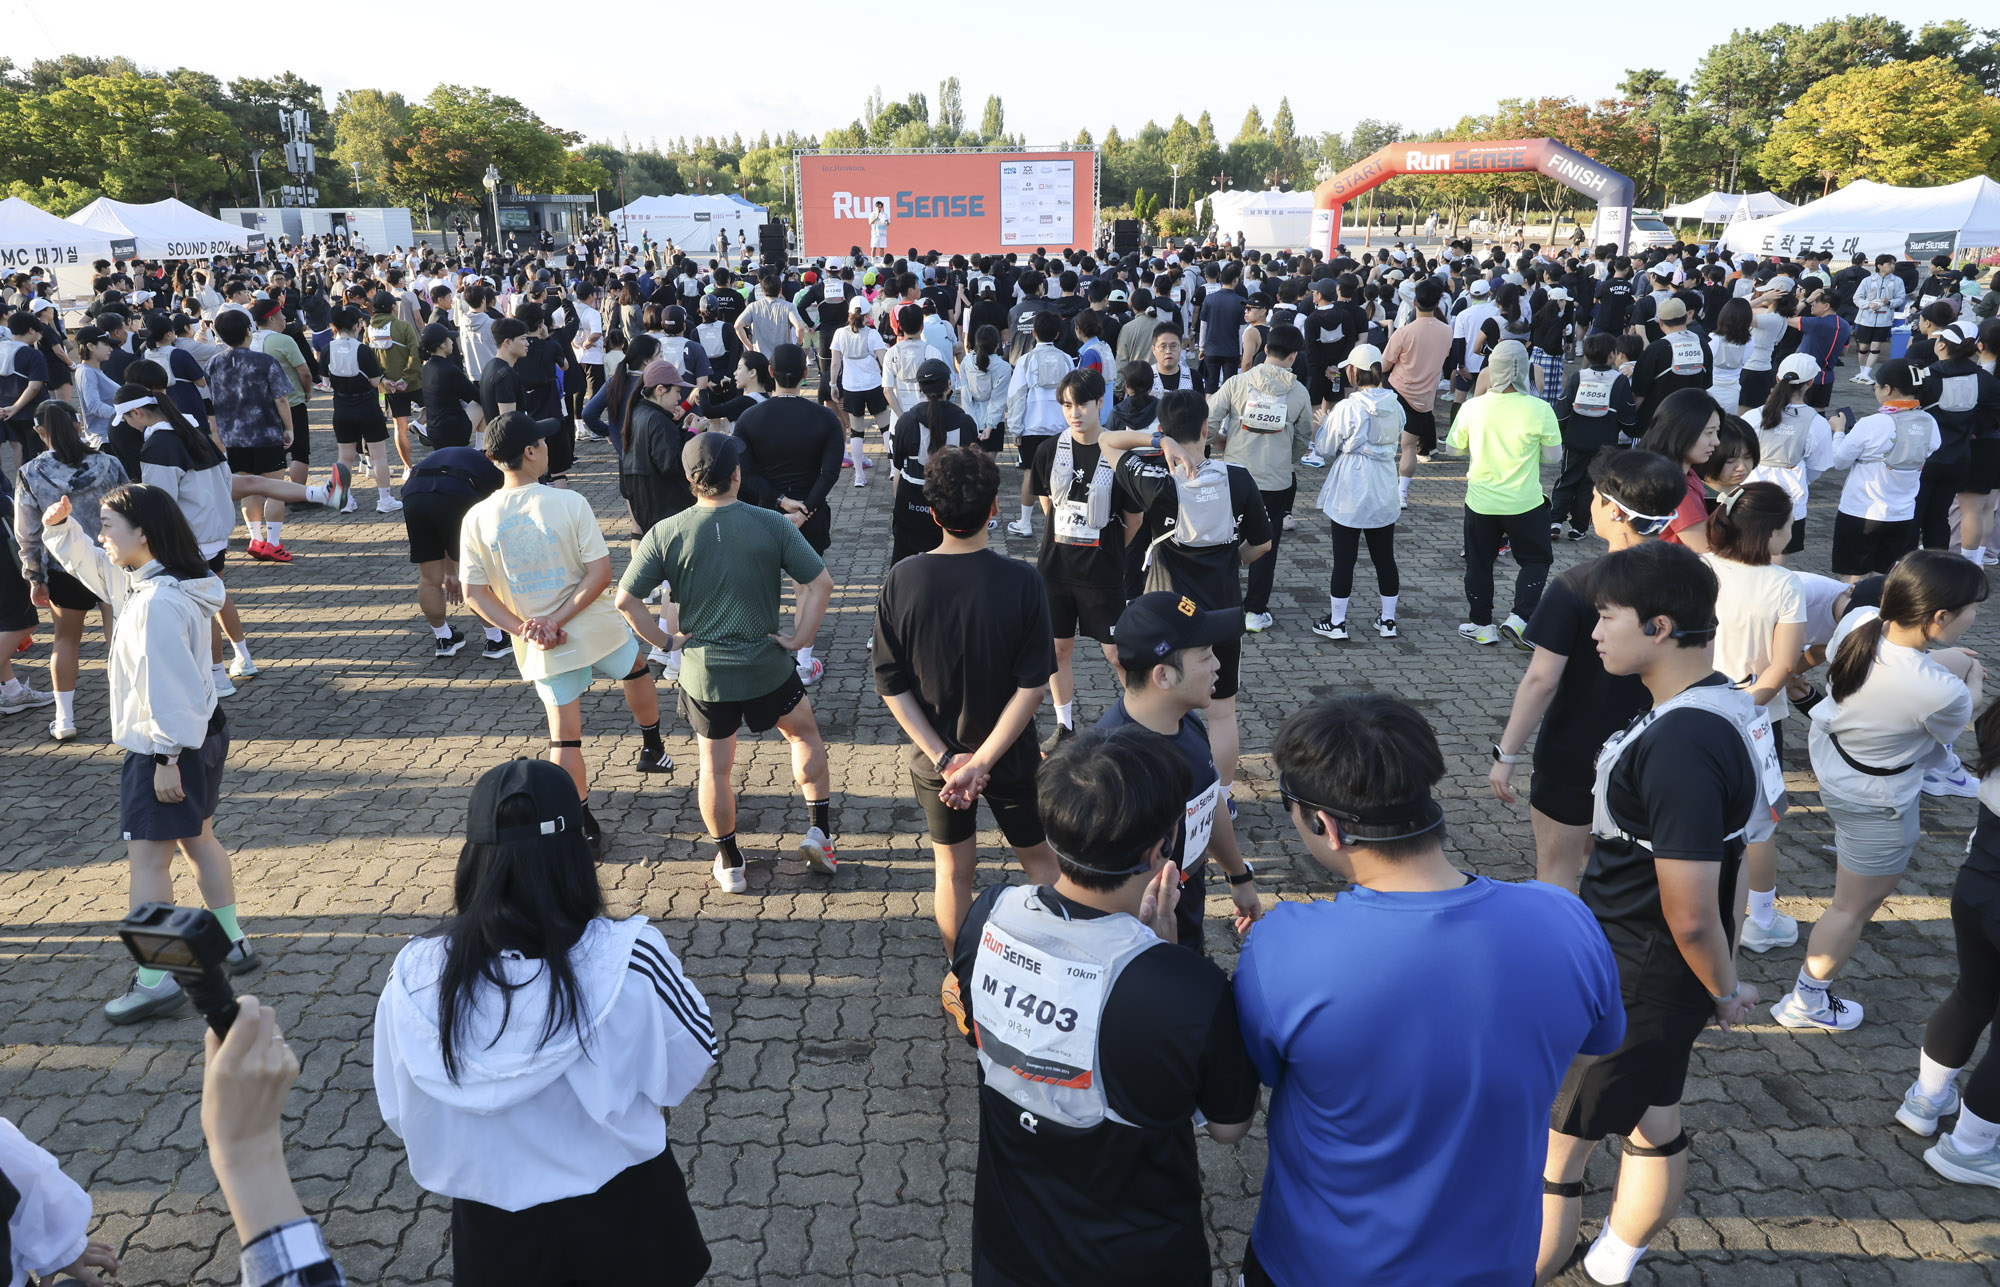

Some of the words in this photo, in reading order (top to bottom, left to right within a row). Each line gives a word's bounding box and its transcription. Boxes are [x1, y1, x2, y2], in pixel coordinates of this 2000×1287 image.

[1333, 158, 1384, 195] START
[1547, 153, 1608, 192] FINISH
[2, 248, 30, 266] MC
[35, 246, 79, 265] 대기실
[168, 241, 207, 256] SOUND
[210, 240, 231, 254] BOX
[1609, 285, 1630, 293] KOREA
[1586, 391, 1607, 399] 5054
[1256, 413, 1282, 423] 5205
[1200, 486, 1216, 495] Run
[908, 501, 915, 511] le
[915, 505, 930, 514] coq
[1190, 825, 1198, 841] M
[982, 931, 1004, 957] Run
[1002, 944, 1042, 976] SENSE
[1066, 966, 1098, 981] 10km
[982, 974, 999, 997] M
[1003, 984, 1079, 1033] 1403
